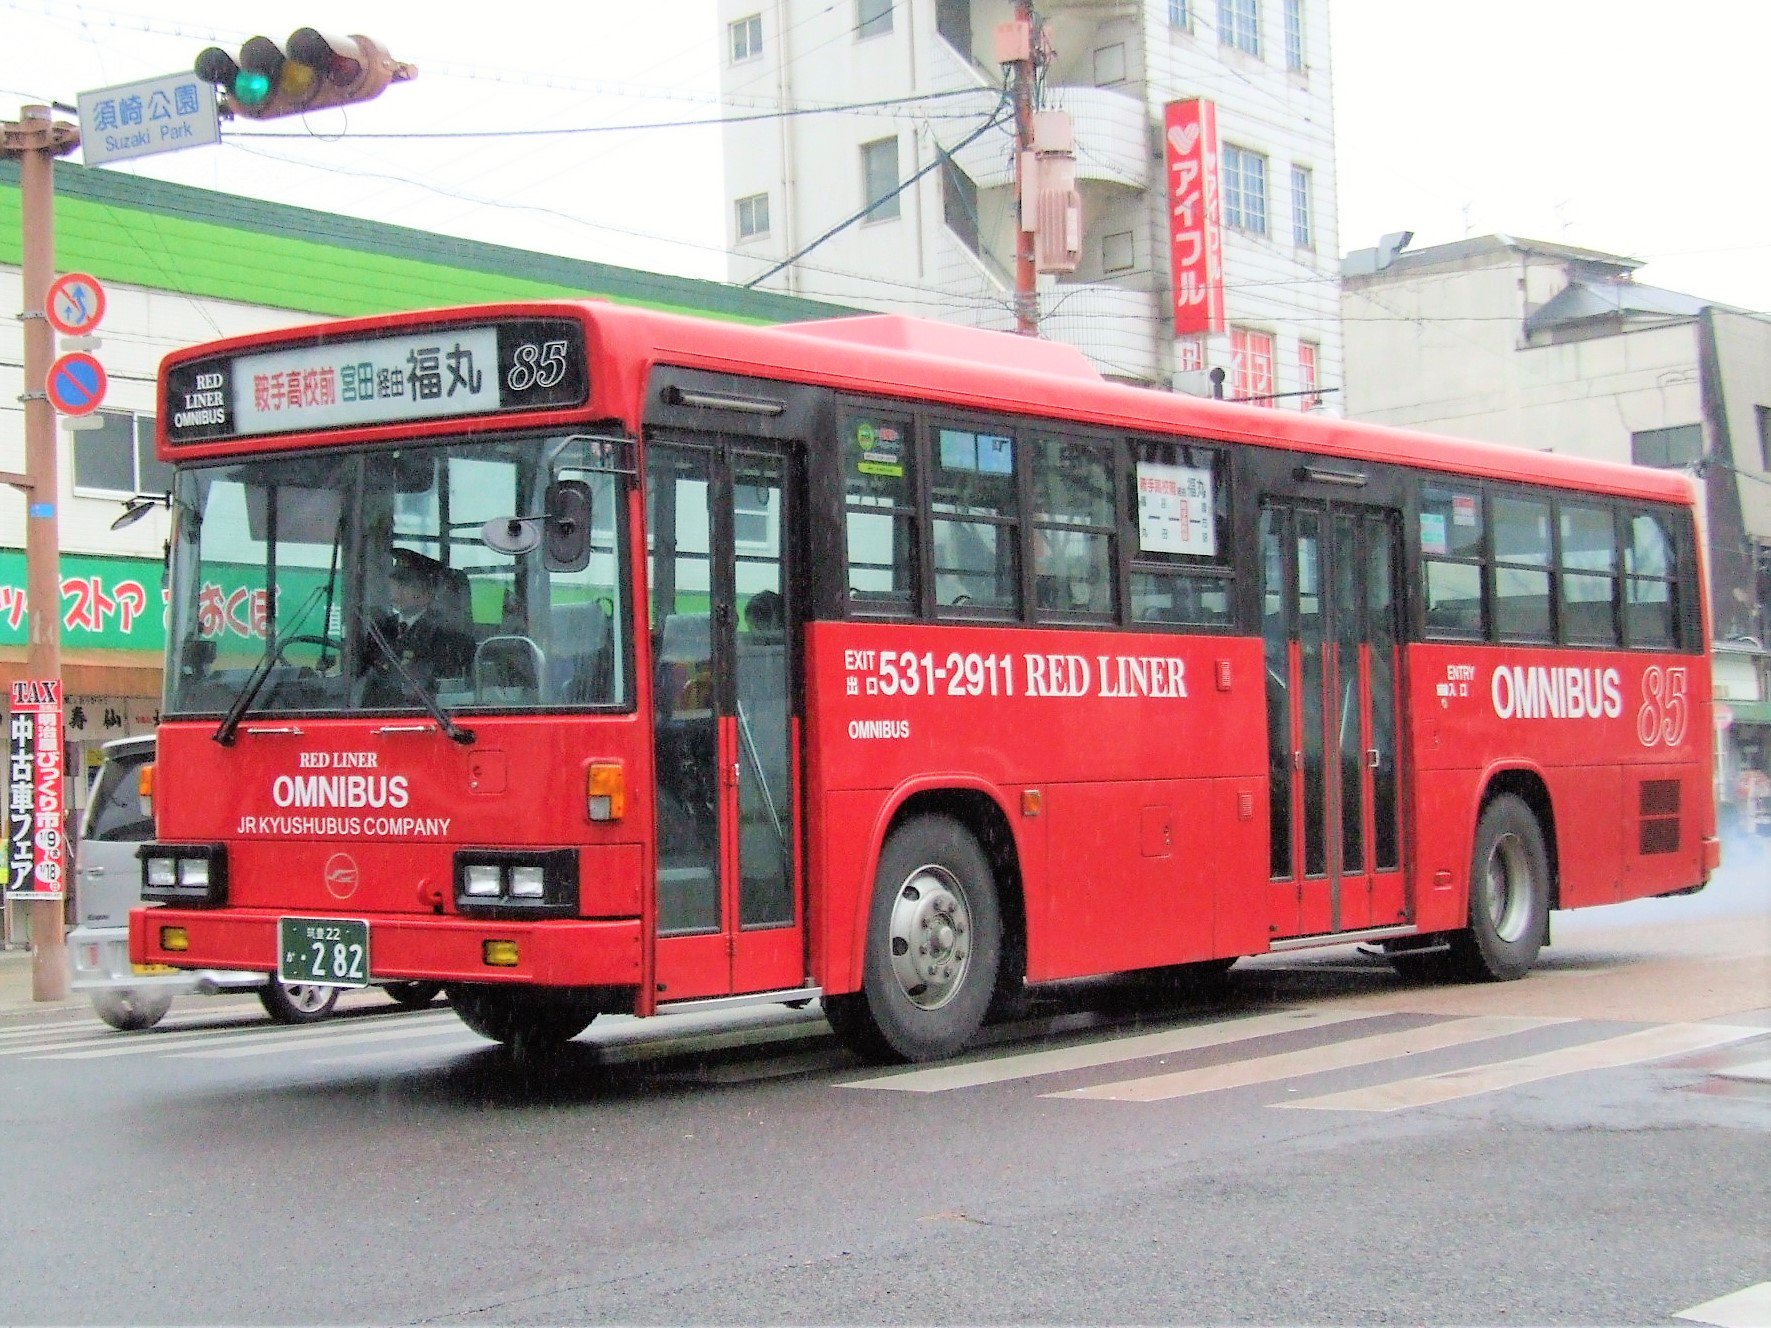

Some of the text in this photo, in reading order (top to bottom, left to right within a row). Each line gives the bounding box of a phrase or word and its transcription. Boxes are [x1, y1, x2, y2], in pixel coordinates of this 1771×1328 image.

[93, 83, 199, 131] 須崎公園
[105, 121, 193, 152] Suzaki Park
[1171, 160, 1206, 307] アイフル
[406, 343, 482, 401] 福丸
[507, 340, 568, 391] 85
[196, 372, 223, 390] RED
[184, 391, 224, 410] LINER
[174, 408, 225, 428] OMNIBUS
[844, 650, 876, 671] EXIT
[1447, 665, 1475, 681] ENTRY
[846, 676, 878, 695] 出口
[879, 650, 1188, 698] 531-2911 RED LINER
[13, 682, 57, 704] TAX
[1491, 665, 1621, 719] OMNIBUS
[1636, 665, 1688, 747] 85
[848, 720, 910, 739] OMNIBUS
[300, 752, 378, 768] RED LINER
[10, 714, 34, 890] 中古車フェア
[273, 775, 409, 808] OMNIBUS
[237, 816, 451, 836] JR KYUSHUBUS COMPANY
